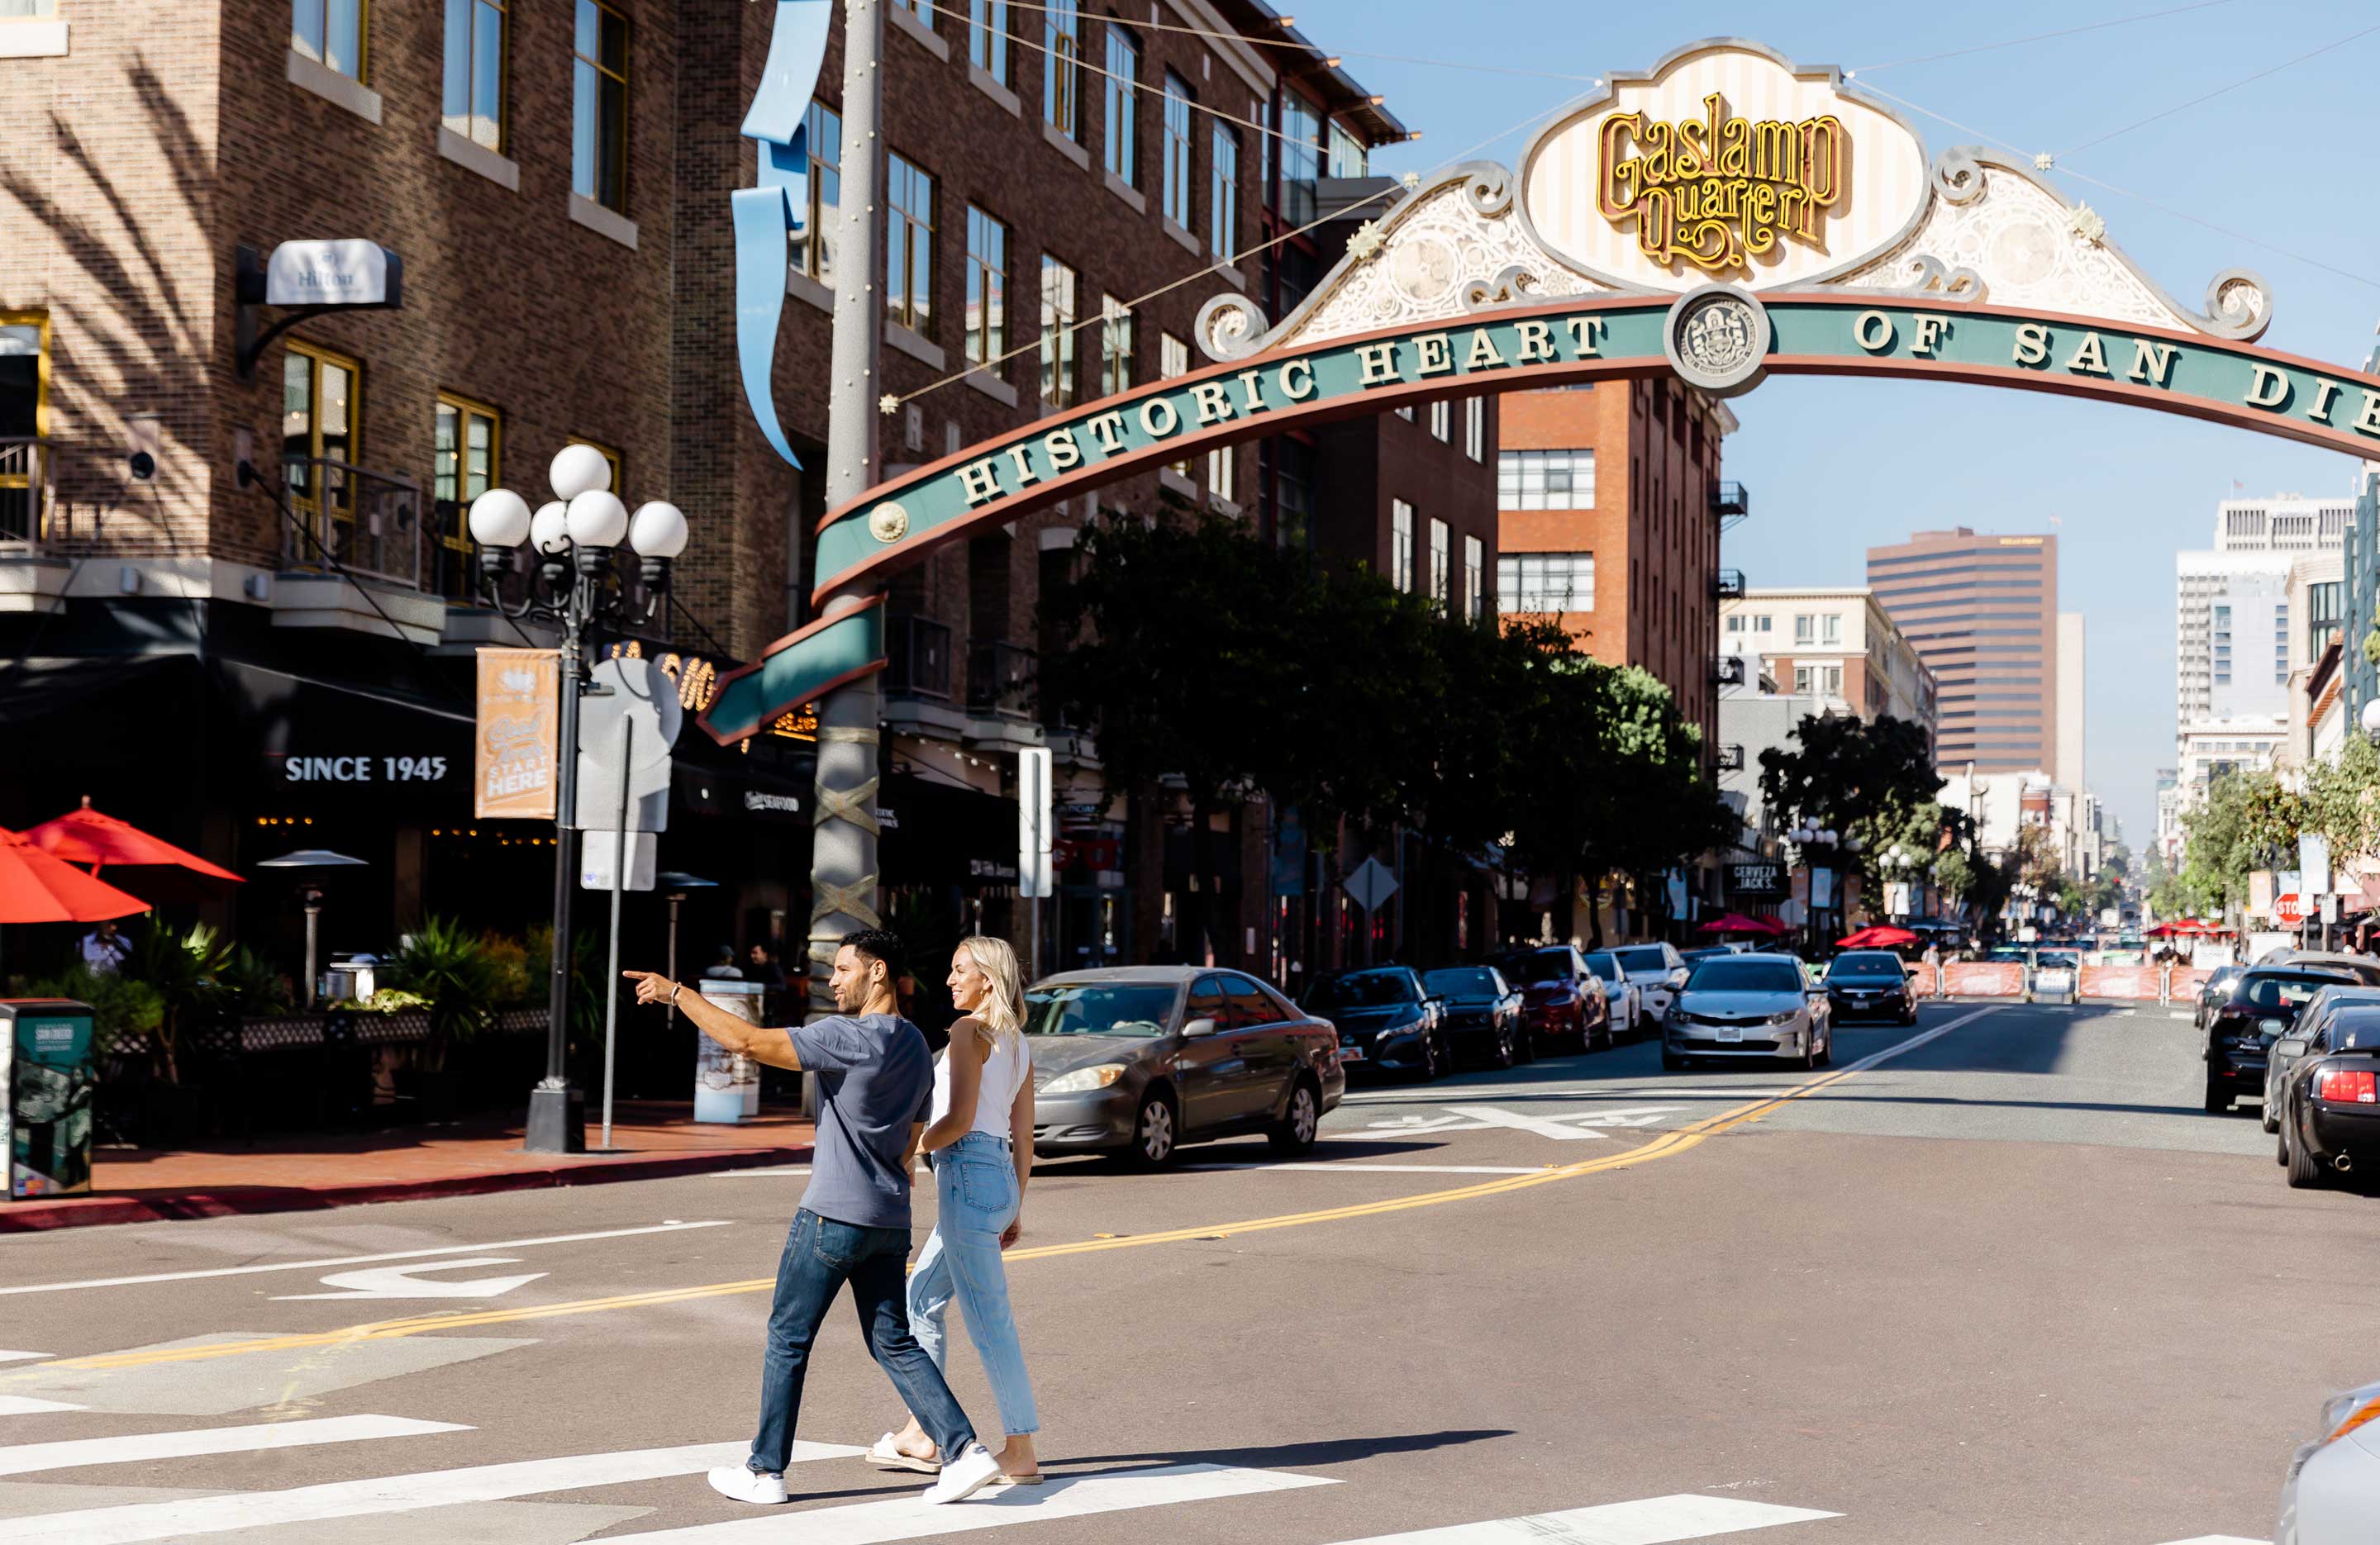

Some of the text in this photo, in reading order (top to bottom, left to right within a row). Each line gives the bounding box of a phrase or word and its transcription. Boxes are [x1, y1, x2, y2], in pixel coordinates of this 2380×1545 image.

[1596, 92, 1844, 242] Gaslamp
[1637, 178, 1810, 269] Quarter
[953, 358, 1318, 506] HISTORIC
[1354, 316, 1602, 385] HEART
[1853, 309, 1949, 354] OF
[2011, 322, 2177, 383] SAN
[285, 756, 448, 782] SINCE 1945
[489, 756, 546, 780] START
[487, 768, 549, 798] HERE
[1734, 865, 1778, 878] CERVEZA
[2277, 900, 2298, 915] STO
